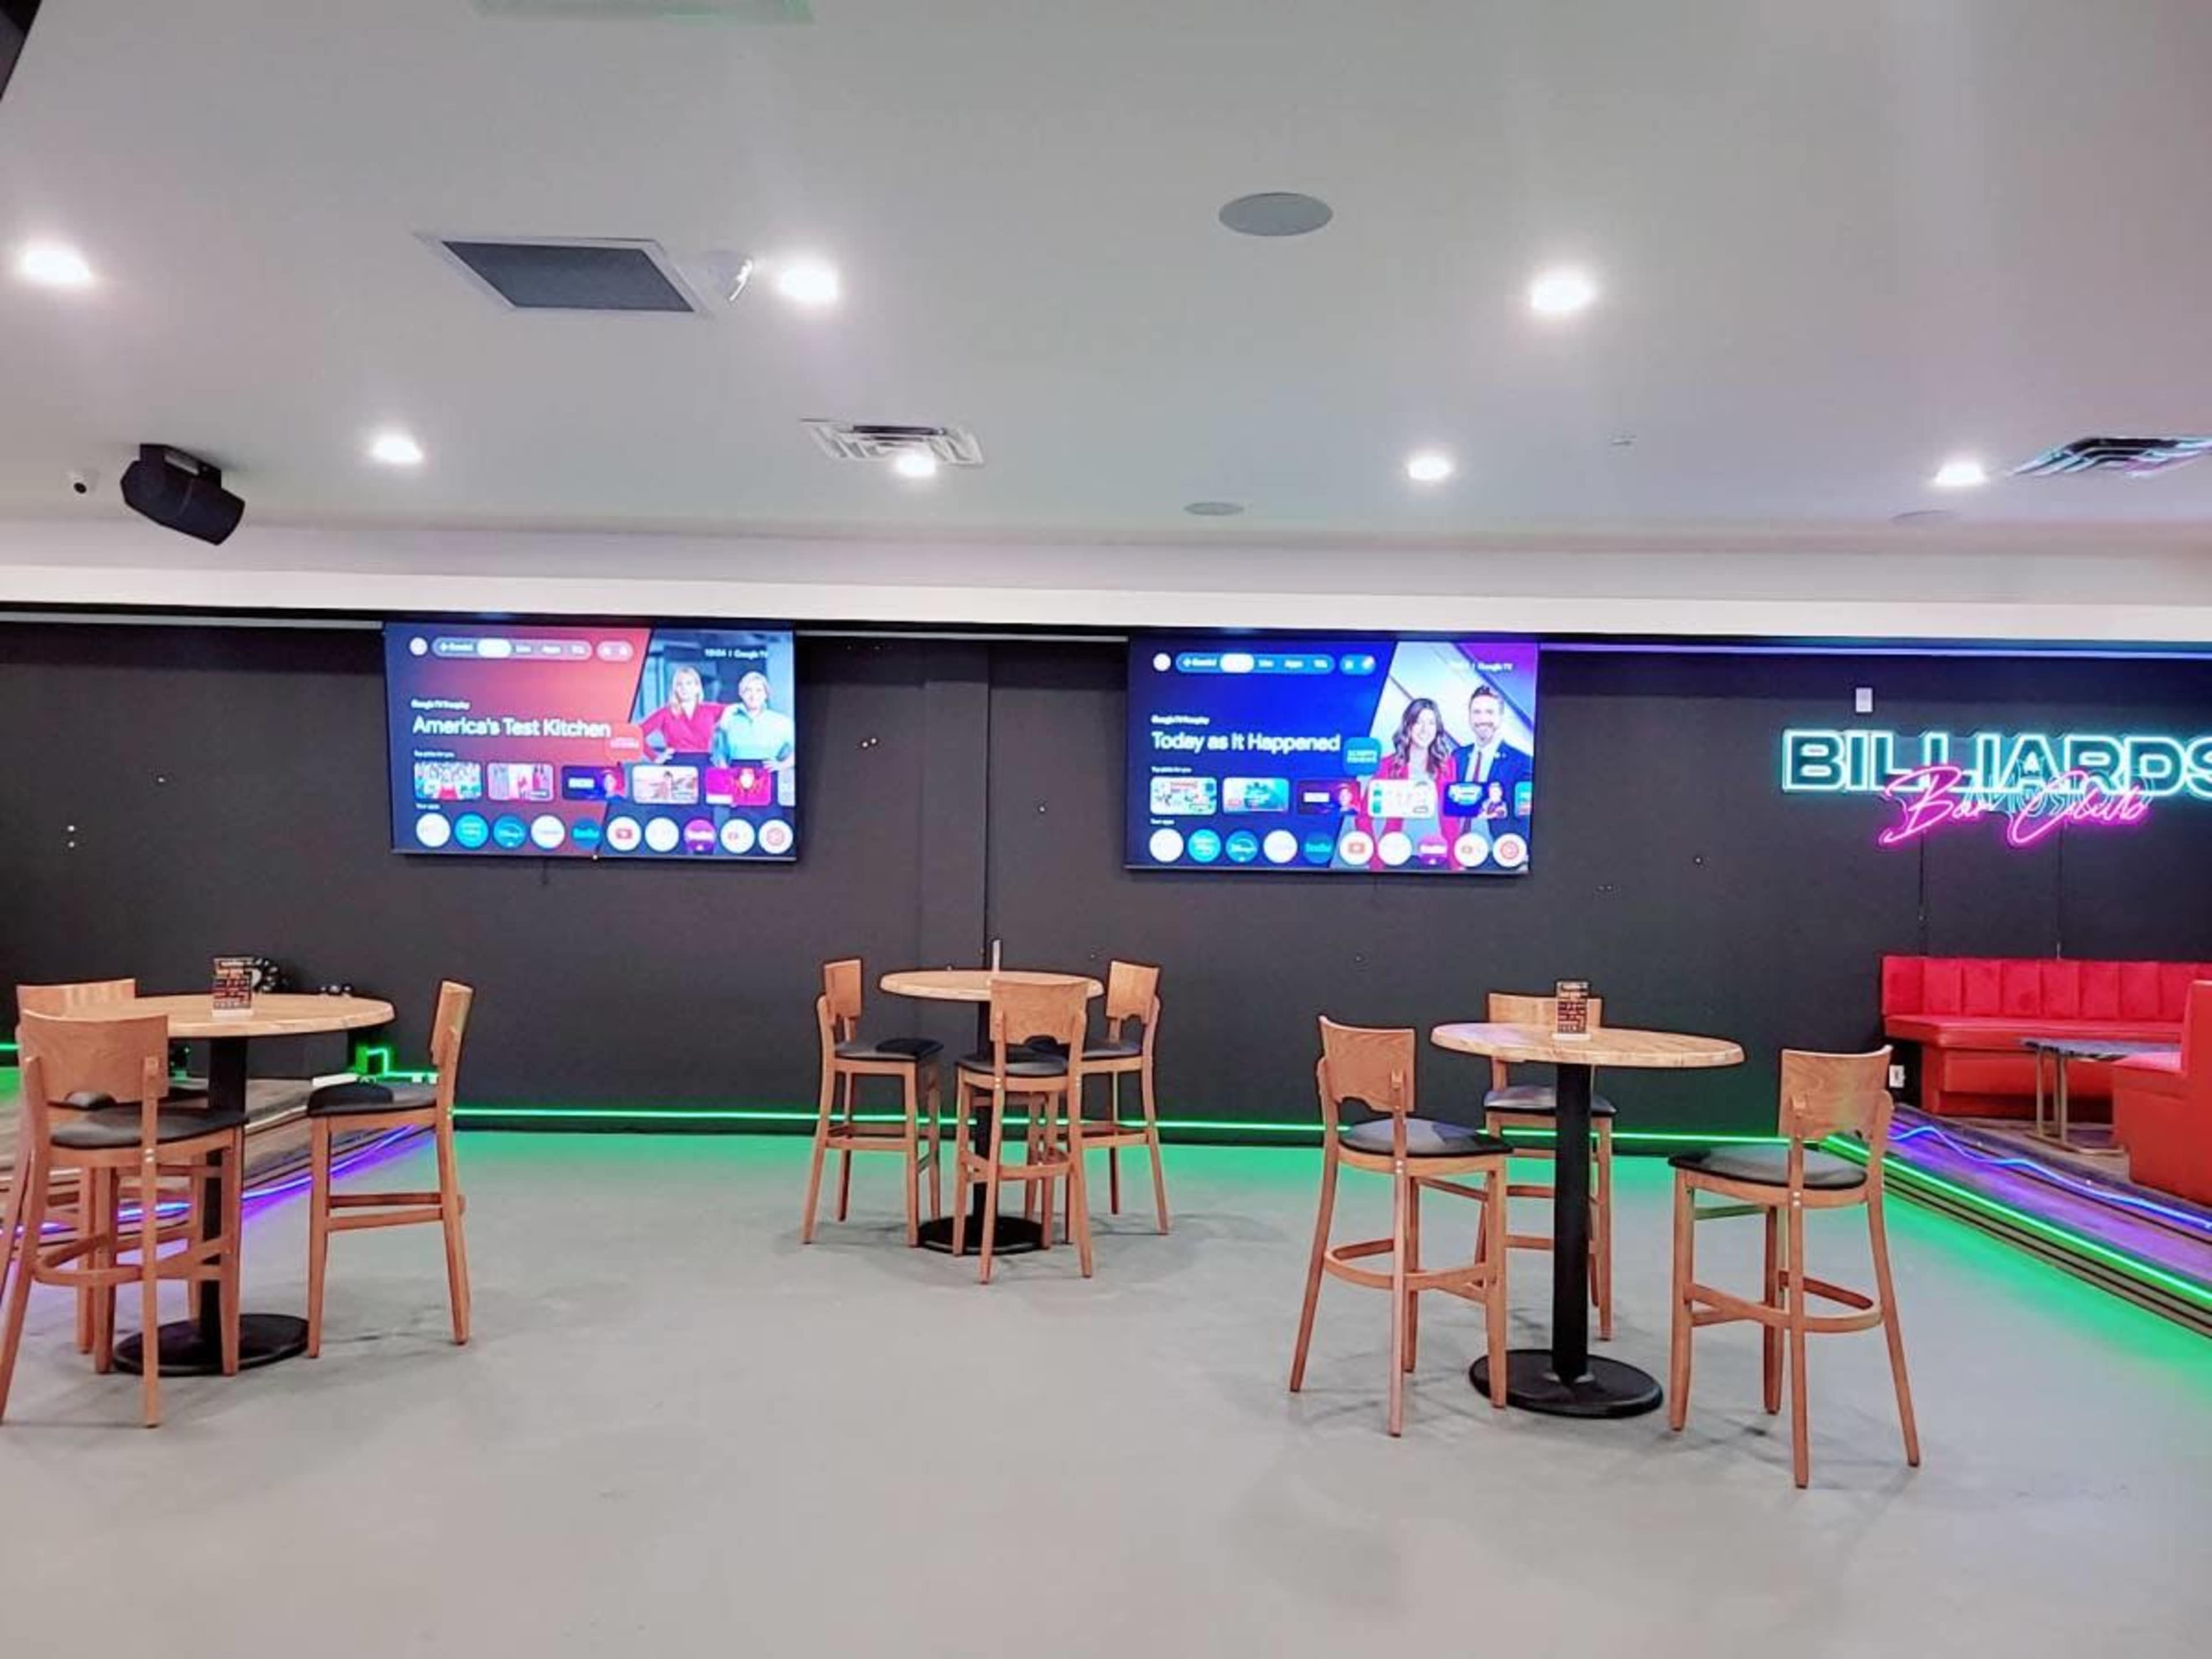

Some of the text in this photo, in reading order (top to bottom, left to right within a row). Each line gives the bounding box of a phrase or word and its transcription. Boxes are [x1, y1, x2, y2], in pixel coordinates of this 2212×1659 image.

[412, 715, 612, 738] America's Test Kitchen
[1152, 730, 1341, 755] Today as It Happened
